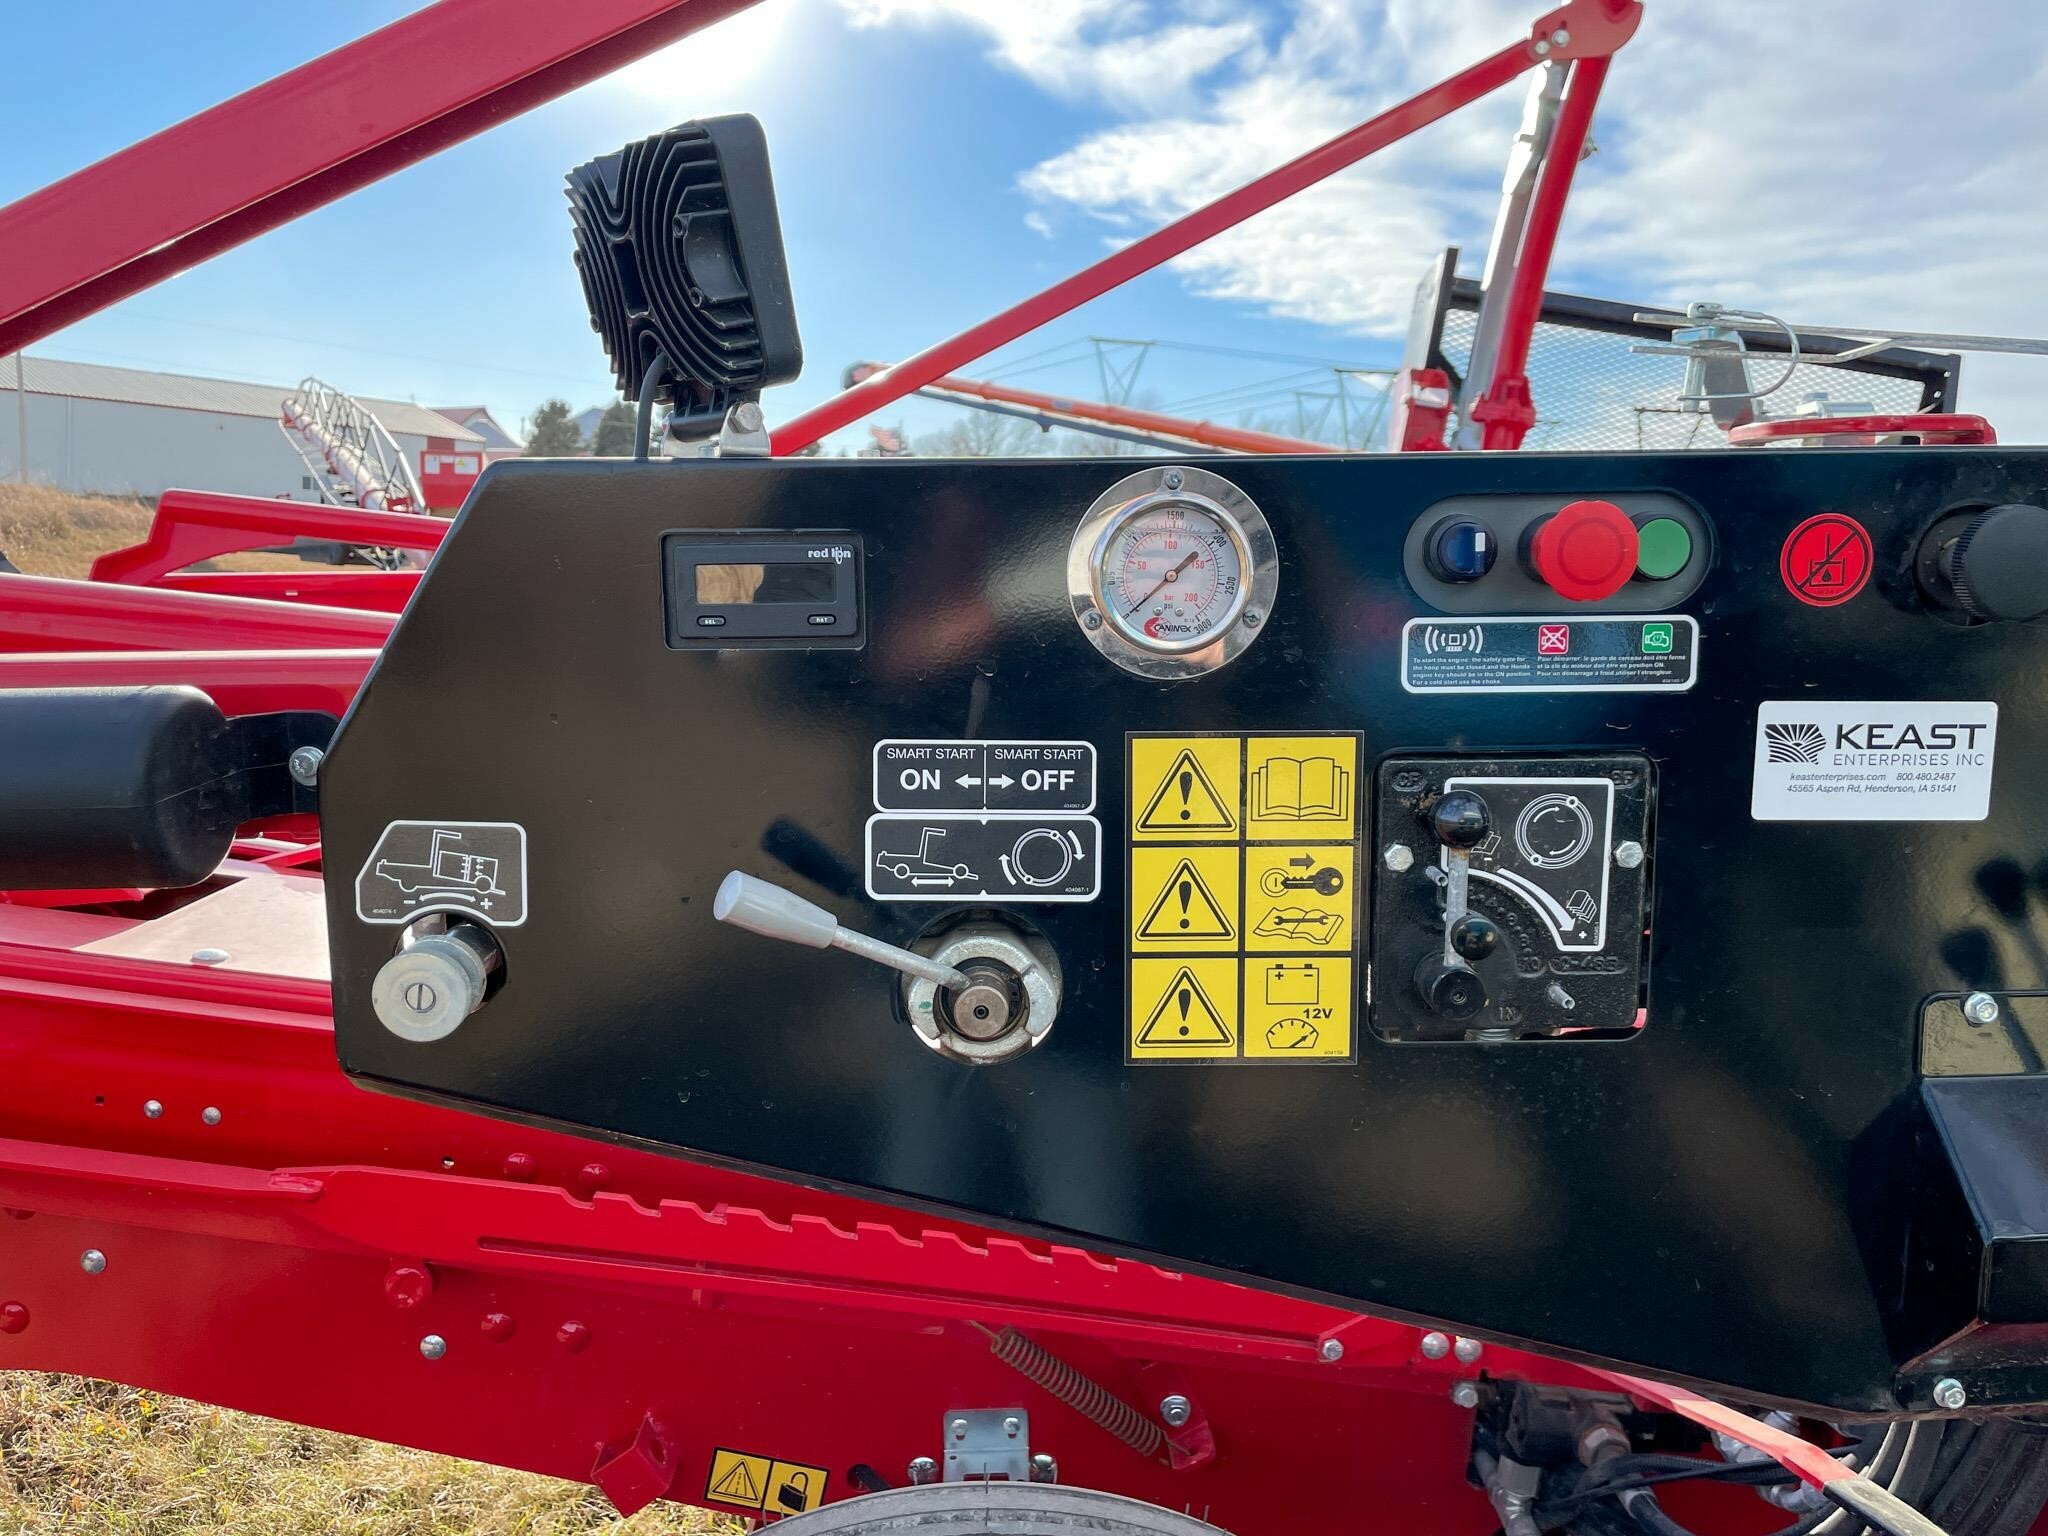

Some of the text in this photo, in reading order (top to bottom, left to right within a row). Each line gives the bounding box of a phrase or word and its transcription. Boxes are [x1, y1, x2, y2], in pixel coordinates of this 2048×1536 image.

[1167, 510, 1185, 520] 1500
[1164, 541, 1178, 550] 100
[807, 547, 829, 558] red
[1137, 561, 1147, 570] 50
[1191, 560, 1205, 569] 150
[1224, 576, 1236, 595] 2500
[1184, 592, 1198, 602] 200
[1153, 624, 1191, 633] CANIMEX
[1194, 618, 1212, 634] 3000
[1835, 723, 1987, 750] KEAST
[886, 747, 976, 760] SMART START
[994, 748, 1084, 760] SMART START
[1833, 753, 1985, 766] ENTERPRISES INC
[899, 768, 941, 791] ON
[1020, 768, 1076, 791] OFF
[1789, 772, 1956, 782] keastenterprises.com 800.480.2487
[1786, 784, 1957, 794] 45565 Aspen Rd, Henderson, IA 51541
[1303, 1008, 1333, 1019] 12V
